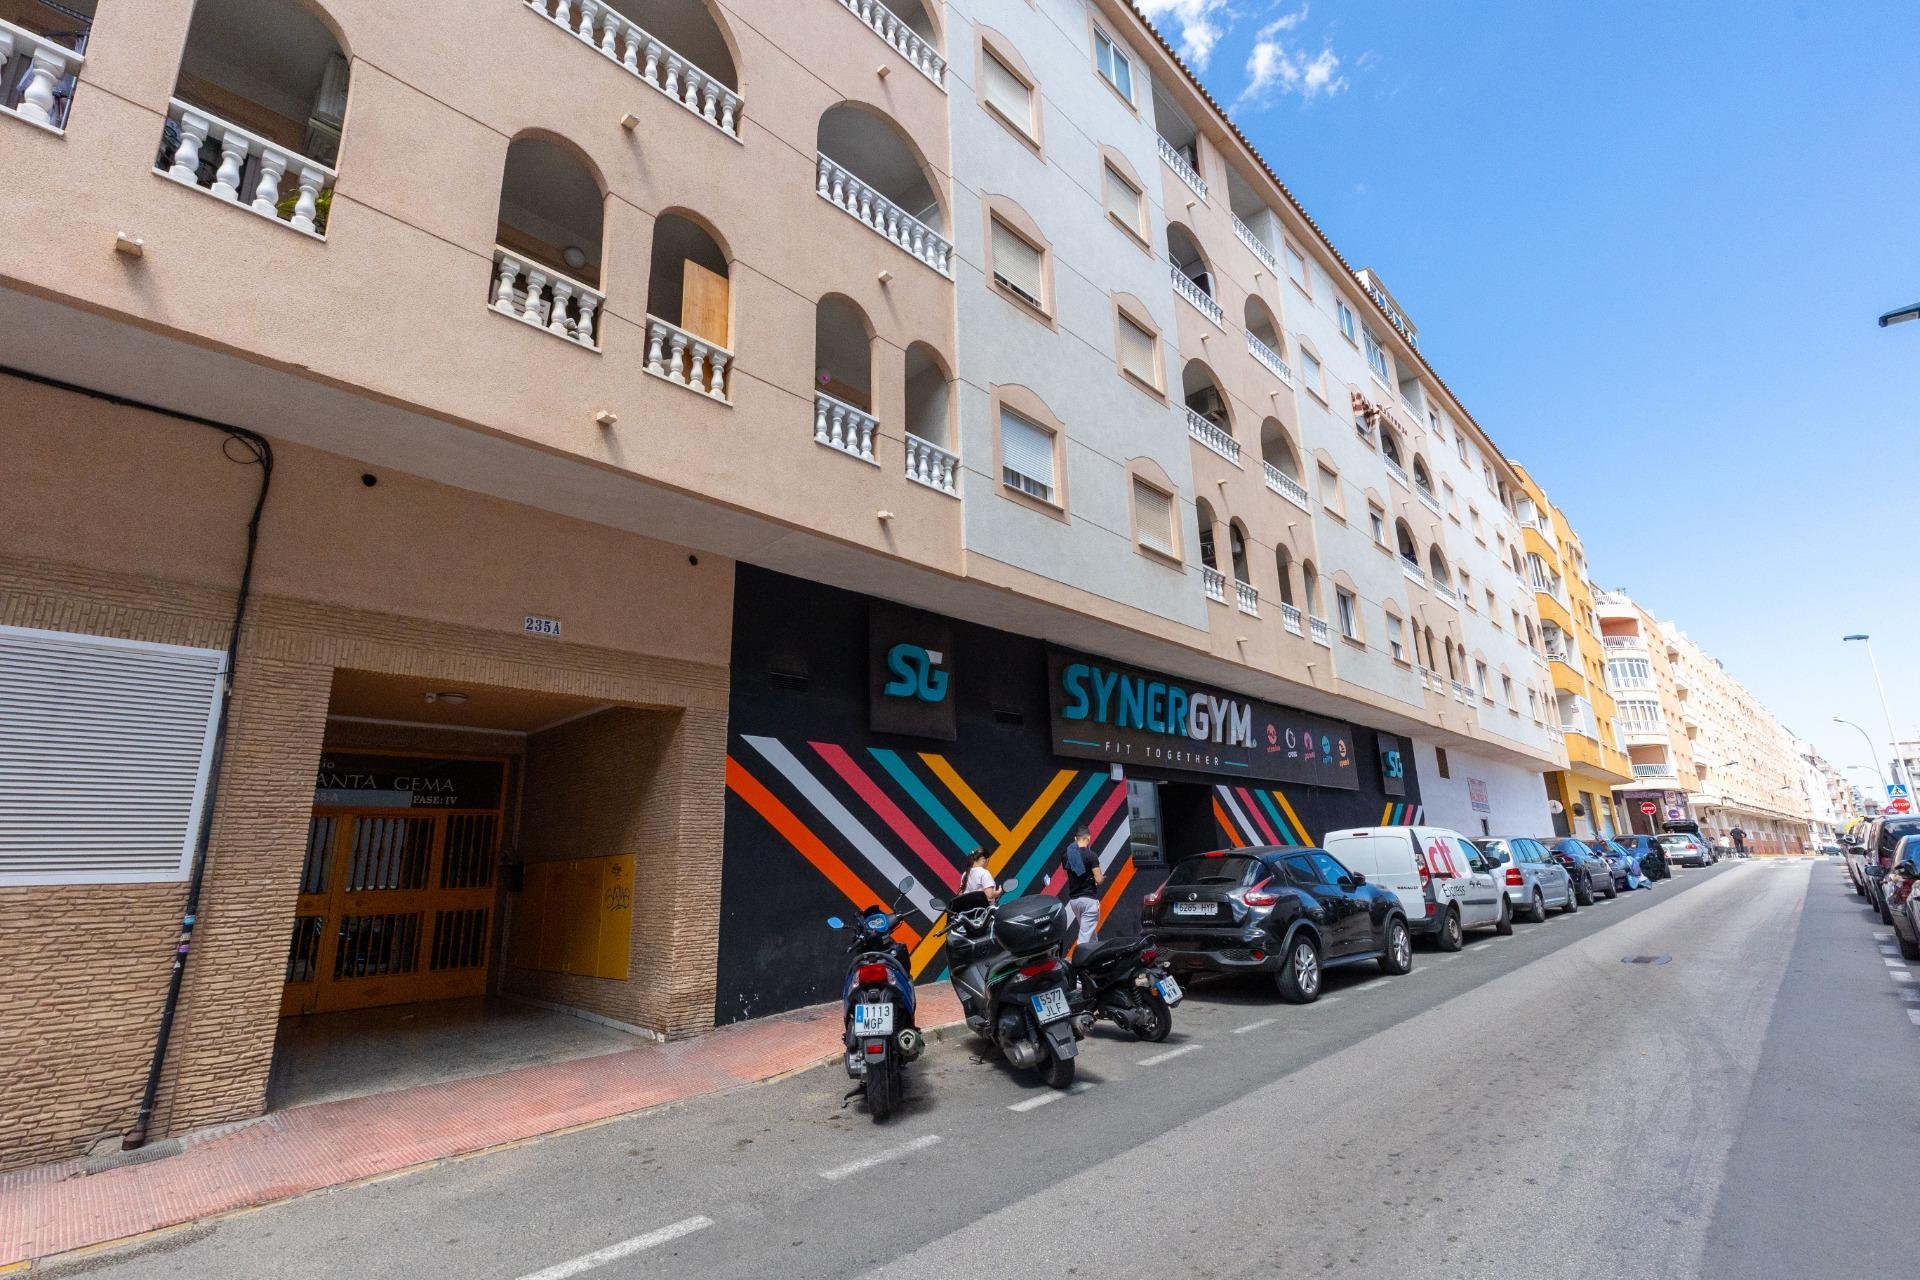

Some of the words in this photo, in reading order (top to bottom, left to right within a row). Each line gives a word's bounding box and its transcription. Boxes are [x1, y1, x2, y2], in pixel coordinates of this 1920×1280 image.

[526, 617, 560, 635] 235A
[884, 643, 950, 703] SG
[1061, 663, 1253, 748] SYNERGYM
[1105, 741, 1131, 754] FIT
[1146, 747, 1219, 766] TOGETHER
[317, 773, 377, 789] ANTA
[393, 776, 454, 792] GEMA
[445, 796, 458, 805] IV
[1201, 903, 1216, 912] HYP
[1039, 989, 1061, 1005] 5577
[865, 1005, 890, 1018] 1113
[1046, 1002, 1062, 1017] JLF
[864, 1017, 884, 1030] MGP
